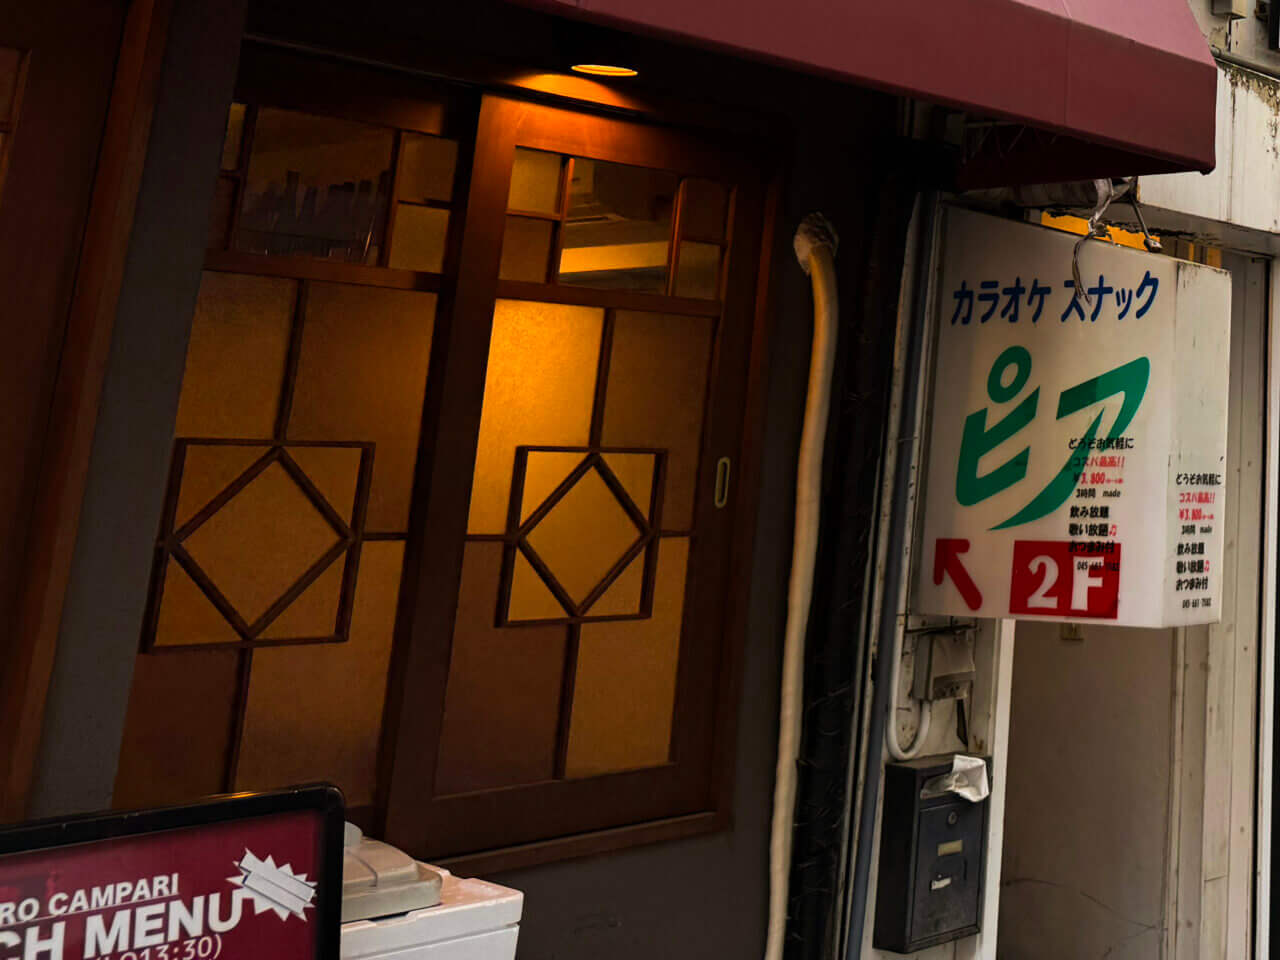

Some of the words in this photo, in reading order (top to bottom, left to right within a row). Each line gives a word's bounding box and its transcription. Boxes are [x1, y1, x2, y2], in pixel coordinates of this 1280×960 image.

[951, 275, 1051, 326] カラオケ
[1060, 270, 1160, 323] スナック
[955, 345, 1151, 531] ピア
[1070, 505, 1109, 518] 飲み放題
[1026, 555, 1104, 611] 2F
[49, 873, 179, 916] CAMPARI
[84, 891, 243, 960] MENU
